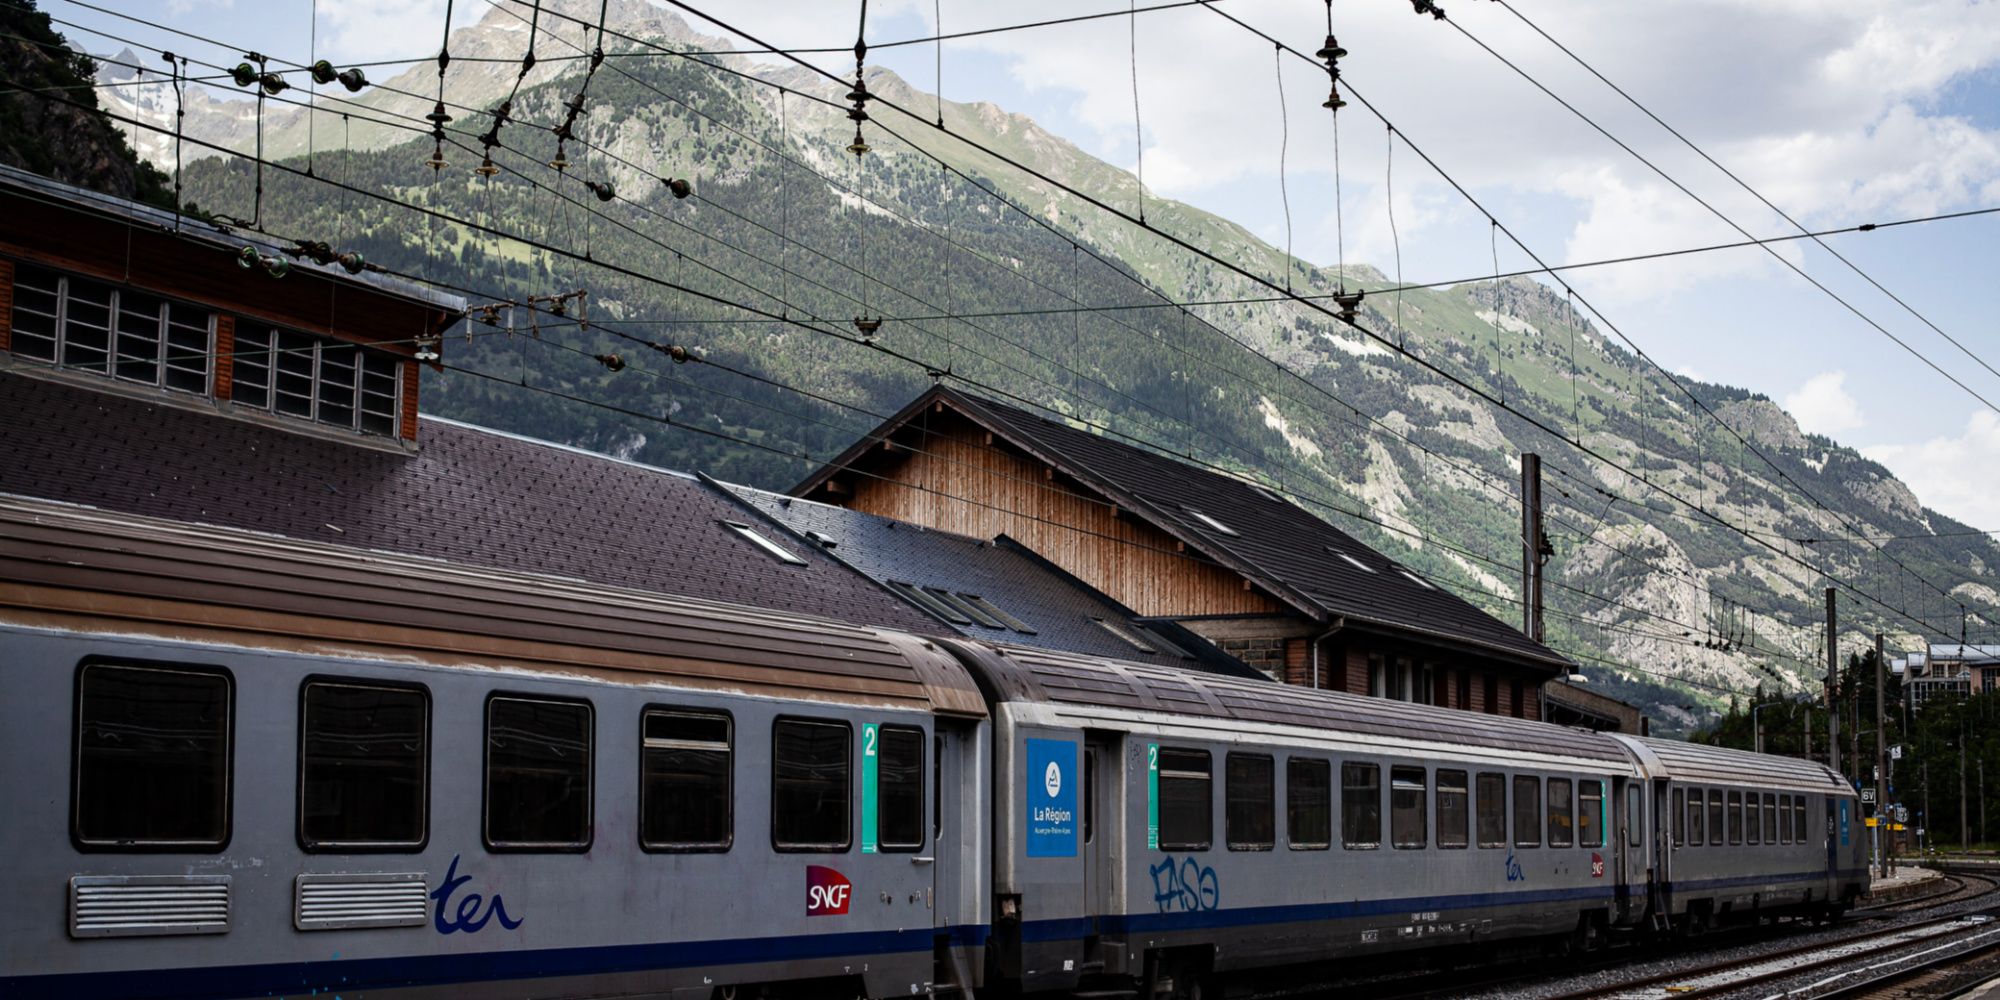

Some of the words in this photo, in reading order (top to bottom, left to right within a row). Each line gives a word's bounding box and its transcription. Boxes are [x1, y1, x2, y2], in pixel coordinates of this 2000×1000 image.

[865, 727, 875, 756] 2
[1149, 746, 1157, 770] 2
[1863, 791, 1874, 800] 6V
[1034, 807, 1044, 821] La
[1046, 806, 1071, 824] Région
[430, 854, 524, 935] ter
[808, 884, 850, 909] SNCF
